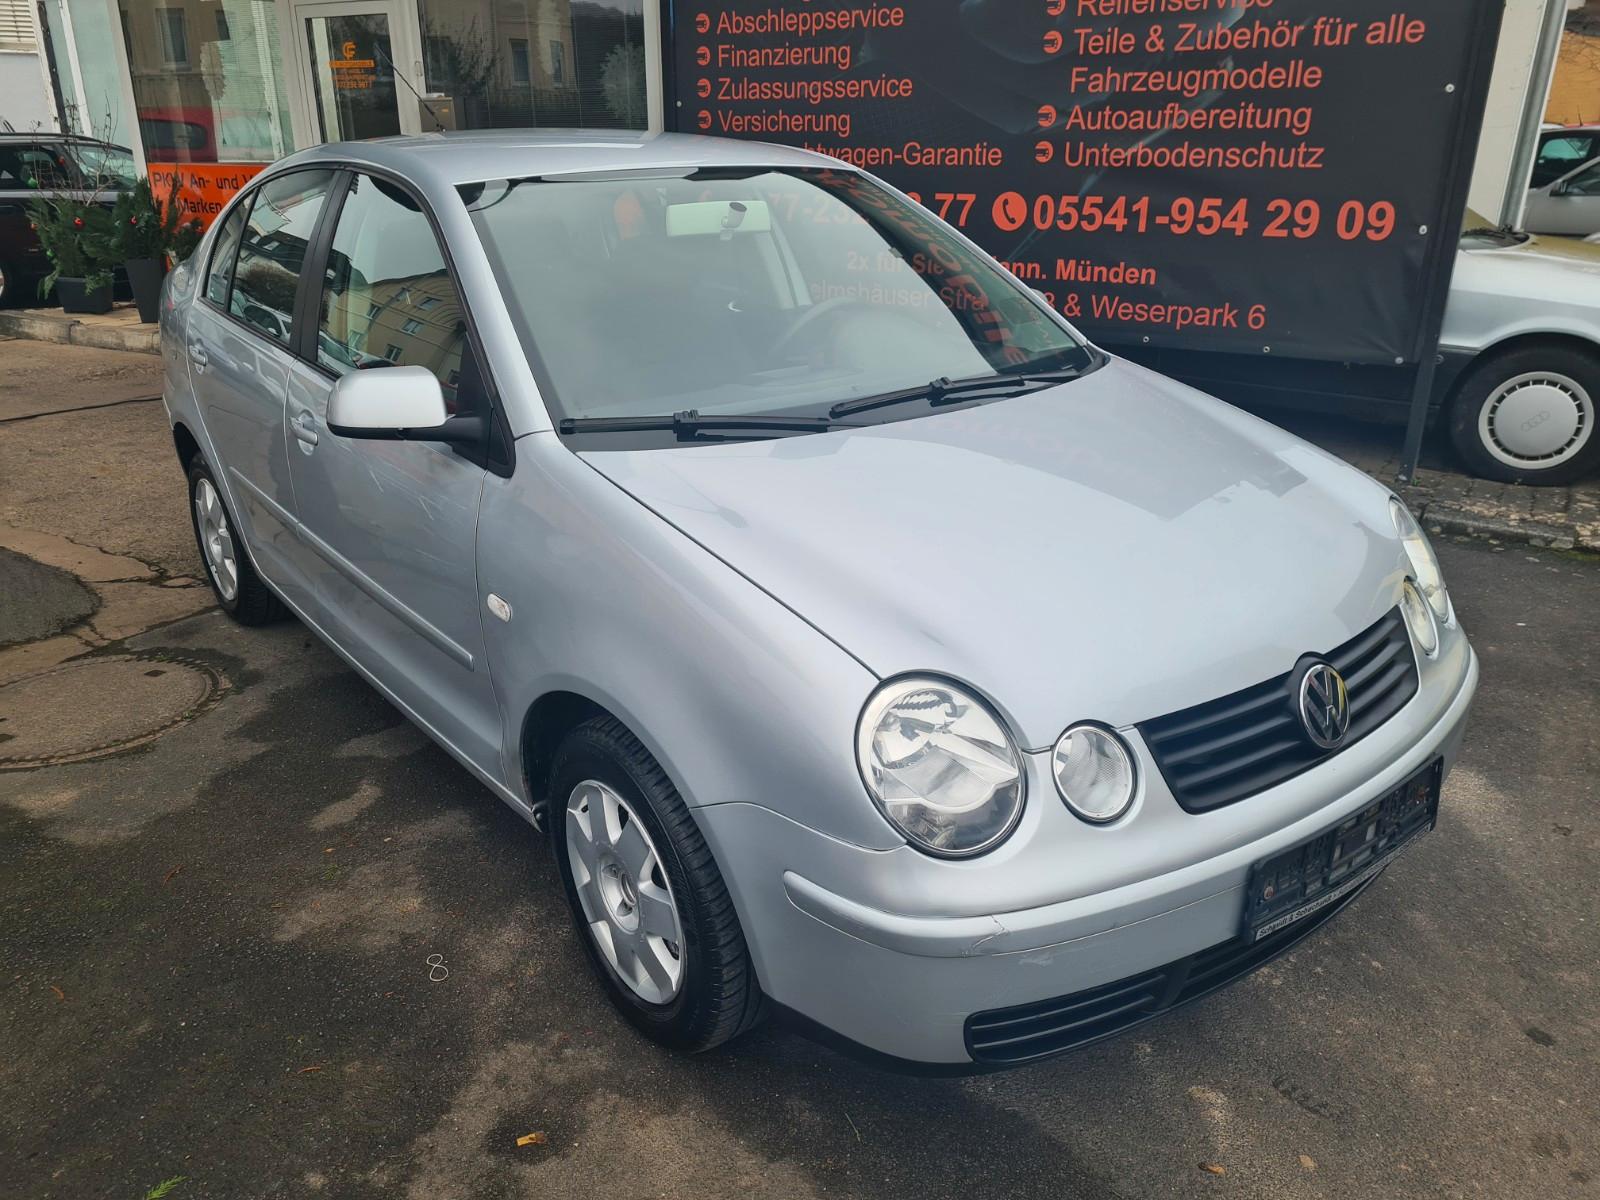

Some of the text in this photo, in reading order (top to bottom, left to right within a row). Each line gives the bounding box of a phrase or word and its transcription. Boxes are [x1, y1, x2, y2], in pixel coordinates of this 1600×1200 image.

[716, 5, 905, 37] Abschleppservice
[1075, 15, 1426, 56] Teile & Zubehör für alle
[717, 43, 851, 70] Finanzierung
[718, 75, 913, 105] Zulassungsservice
[1070, 60, 1323, 98] Fahrzeugmodelle
[719, 110, 851, 138] Versicherung
[1065, 102, 1313, 137] Autoaufbereitung
[805, 142, 1003, 167] twagen-Garantie
[1064, 141, 1325, 170] Unterbodenschutz
[152, 172, 185, 188] PKW
[190, 173, 211, 189] An-
[217, 174, 240, 190] und
[1033, 194, 1396, 241] 05541-954 29 09
[848, 251, 869, 272] 2x
[1055, 258, 1157, 285] Münden
[1063, 292, 1082, 318] &
[1091, 295, 1238, 330] Weserpark
[1247, 303, 1267, 331] 6
